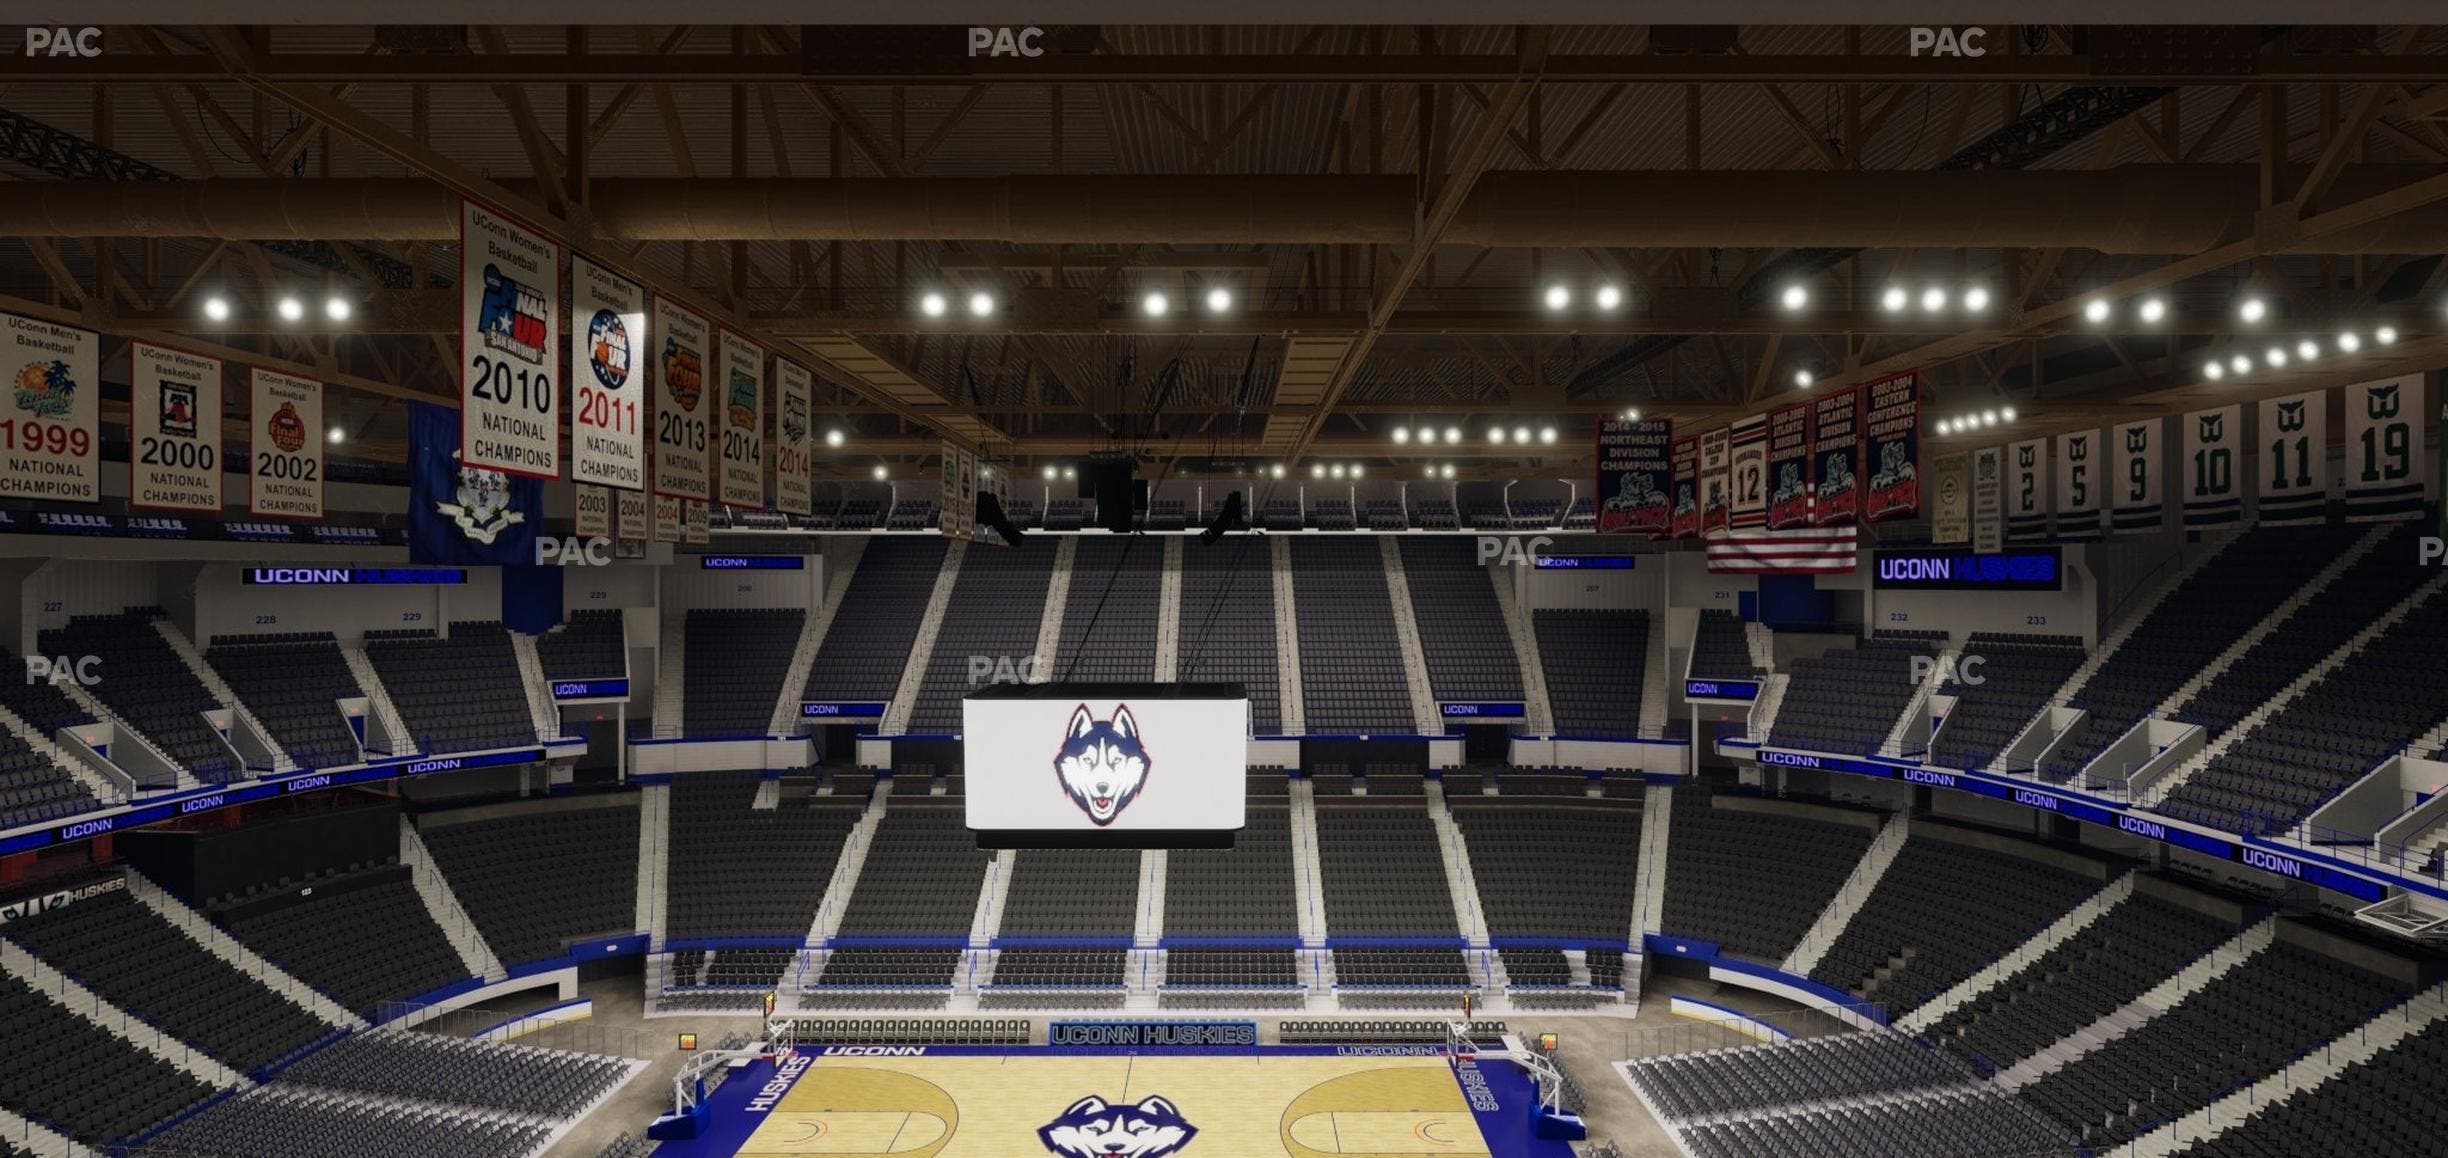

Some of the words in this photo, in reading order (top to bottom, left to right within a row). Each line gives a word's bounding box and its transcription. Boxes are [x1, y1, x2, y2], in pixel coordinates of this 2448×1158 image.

[473, 210, 507, 237] UConn
[509, 229, 550, 259] Women's
[488, 240, 537, 274] Basketball
[586, 264, 612, 288] UConn
[613, 276, 633, 296] Men's
[591, 286, 628, 311] Basketball
[9, 317, 47, 335] UConn
[50, 328, 82, 343] Men's
[17, 334, 75, 355] Basketball
[140, 346, 173, 362] UConn
[174, 353, 214, 370] Women's
[155, 364, 201, 381] Basketball
[258, 373, 283, 385] UConn
[285, 378, 316, 392] Women's
[472, 355, 550, 413] 2010
[269, 387, 306, 402] Basketball
[1874, 389, 1910, 410] EASTERN
[579, 387, 635, 435] 2011
[1868, 401, 1917, 424] CONFERENCE
[483, 412, 545, 441] NATIONAL
[660, 411, 706, 452] 2013
[1603, 422, 1630, 432] 2014
[1640, 421, 1666, 432] 2015
[1869, 416, 1914, 437] CHAMPIONS
[0, 419, 90, 457] 1999
[586, 436, 634, 459] NATIONAL
[724, 430, 760, 465] 2014
[1600, 435, 1669, 445] NORTHEAST
[1816, 434, 1856, 453] CHAMPIONS
[141, 437, 214, 470] 2000
[475, 440, 551, 468] CHAMPIONS
[1609, 448, 1660, 458] DIVISION
[2361, 422, 2410, 482] 19
[9, 458, 84, 477] NATIONAL
[258, 453, 317, 482] 2002
[581, 459, 638, 482] CHAMPIONS
[665, 453, 702, 473] NATIONAL
[779, 446, 809, 478] 2014
[1601, 461, 1668, 471] CHAMPIONS
[2272, 436, 2312, 489] 11
[150, 472, 209, 488] NATIONAL
[728, 468, 758, 484] NATIONAL
[2130, 457, 2145, 501] 9
[2195, 448, 2231, 496] 10
[1, 478, 90, 497] CHAMPIONS
[265, 484, 312, 498] NATIONAL
[661, 474, 706, 494] CHAMPIONS
[1738, 464, 1759, 502] 12
[2022, 472, 2034, 511] 2
[2072, 465, 2085, 506] 5
[143, 490, 215, 506] CHAMPIONS
[579, 494, 606, 513] 2003
[725, 486, 760, 503] CHAMPIONS
[260, 499, 317, 513] CHAMPIONS
[621, 500, 645, 517] 2004
[657, 504, 677, 520] 2004
[688, 508, 707, 524] 2009
[705, 558, 748, 568] UCONN
[1881, 558, 1949, 580] UCONN
[1954, 556, 2055, 581] HUSKIES
[254, 569, 349, 583] UCONN
[44, 602, 62, 611] 227
[256, 616, 276, 624] 228
[403, 613, 421, 621] 229
[1891, 613, 1908, 621] 232
[2027, 616, 2046, 625] 233
[555, 683, 588, 695] UCONN
[1687, 683, 1717, 695] UCONN
[804, 704, 839, 715] UCONN
[1444, 704, 1478, 714] UCONN
[407, 760, 461, 774] UCONN
[1762, 752, 1819, 768] UCONN
[288, 776, 330, 792] UCONN
[1904, 769, 1955, 787] UCONN
[182, 795, 223, 813] UCONN
[2015, 790, 2057, 811] UCONN
[62, 818, 112, 840] UCONN
[2118, 817, 2165, 840] UCONN
[2243, 848, 2300, 878] UCONN
[69, 878, 125, 904] HUSKIES
[1053, 1025, 1139, 1044] UCONN
[1144, 1025, 1254, 1044] HUSKIES
[823, 1046, 926, 1056] UCONN
[1337, 1046, 1438, 1056] UCONN
[745, 1056, 810, 1112] HUSKIES
[1457, 1060, 1499, 1112] USKIES
